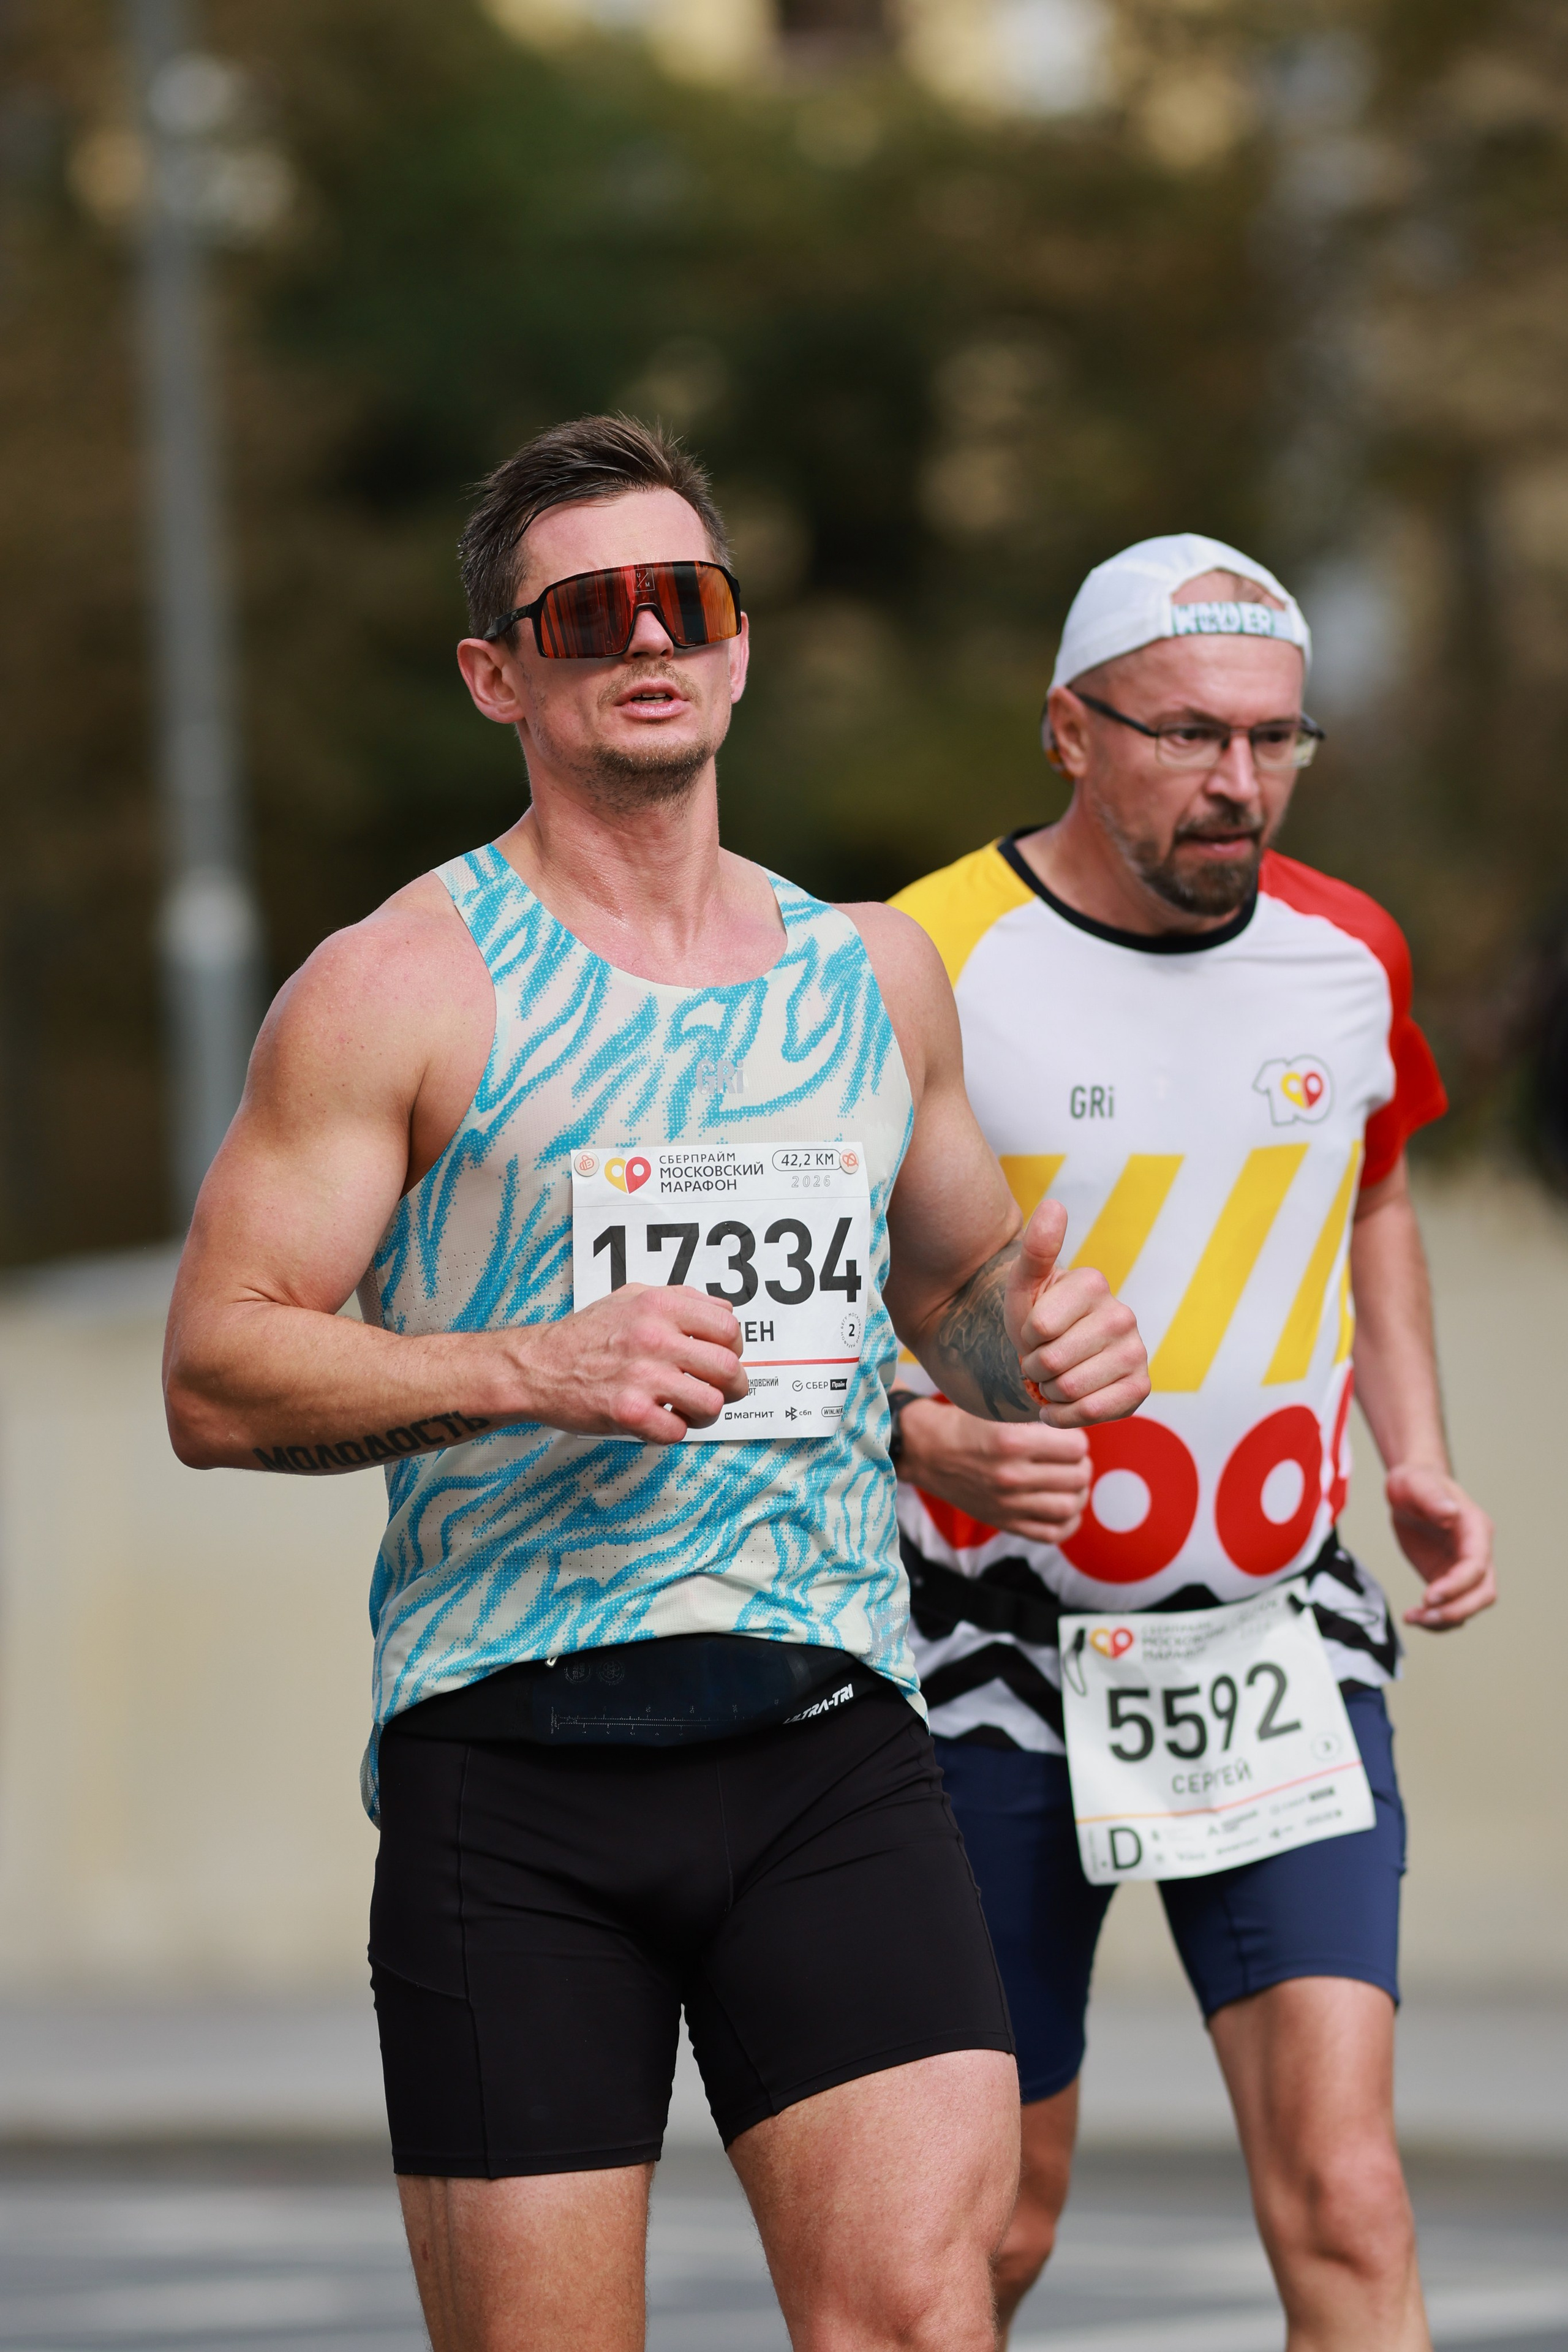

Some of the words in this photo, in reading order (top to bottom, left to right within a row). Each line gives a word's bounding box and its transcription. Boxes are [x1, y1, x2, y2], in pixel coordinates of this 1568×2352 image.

[696, 1060, 744, 1095] GRi
[1070, 1085, 1115, 1119] GRi
[659, 1151, 736, 1164] СБЕРПРАЙМ
[660, 1161, 764, 1178] МОСКОВСКИЙ
[781, 1153, 810, 1167] 42,2
[660, 1179, 737, 1193] МАРАФОН
[791, 1175, 831, 1188] 2026
[593, 1217, 862, 1308] 17334
[848, 1323, 855, 1337] 2
[747, 1376, 779, 1387] КОВСКИЙ
[252, 1410, 491, 1471] МОЛОДОСТЬ
[1106, 1662, 1302, 1763] 5592
[1171, 1757, 1253, 1795] СЕРГЕЙ
[1109, 1826, 1143, 1871] D
